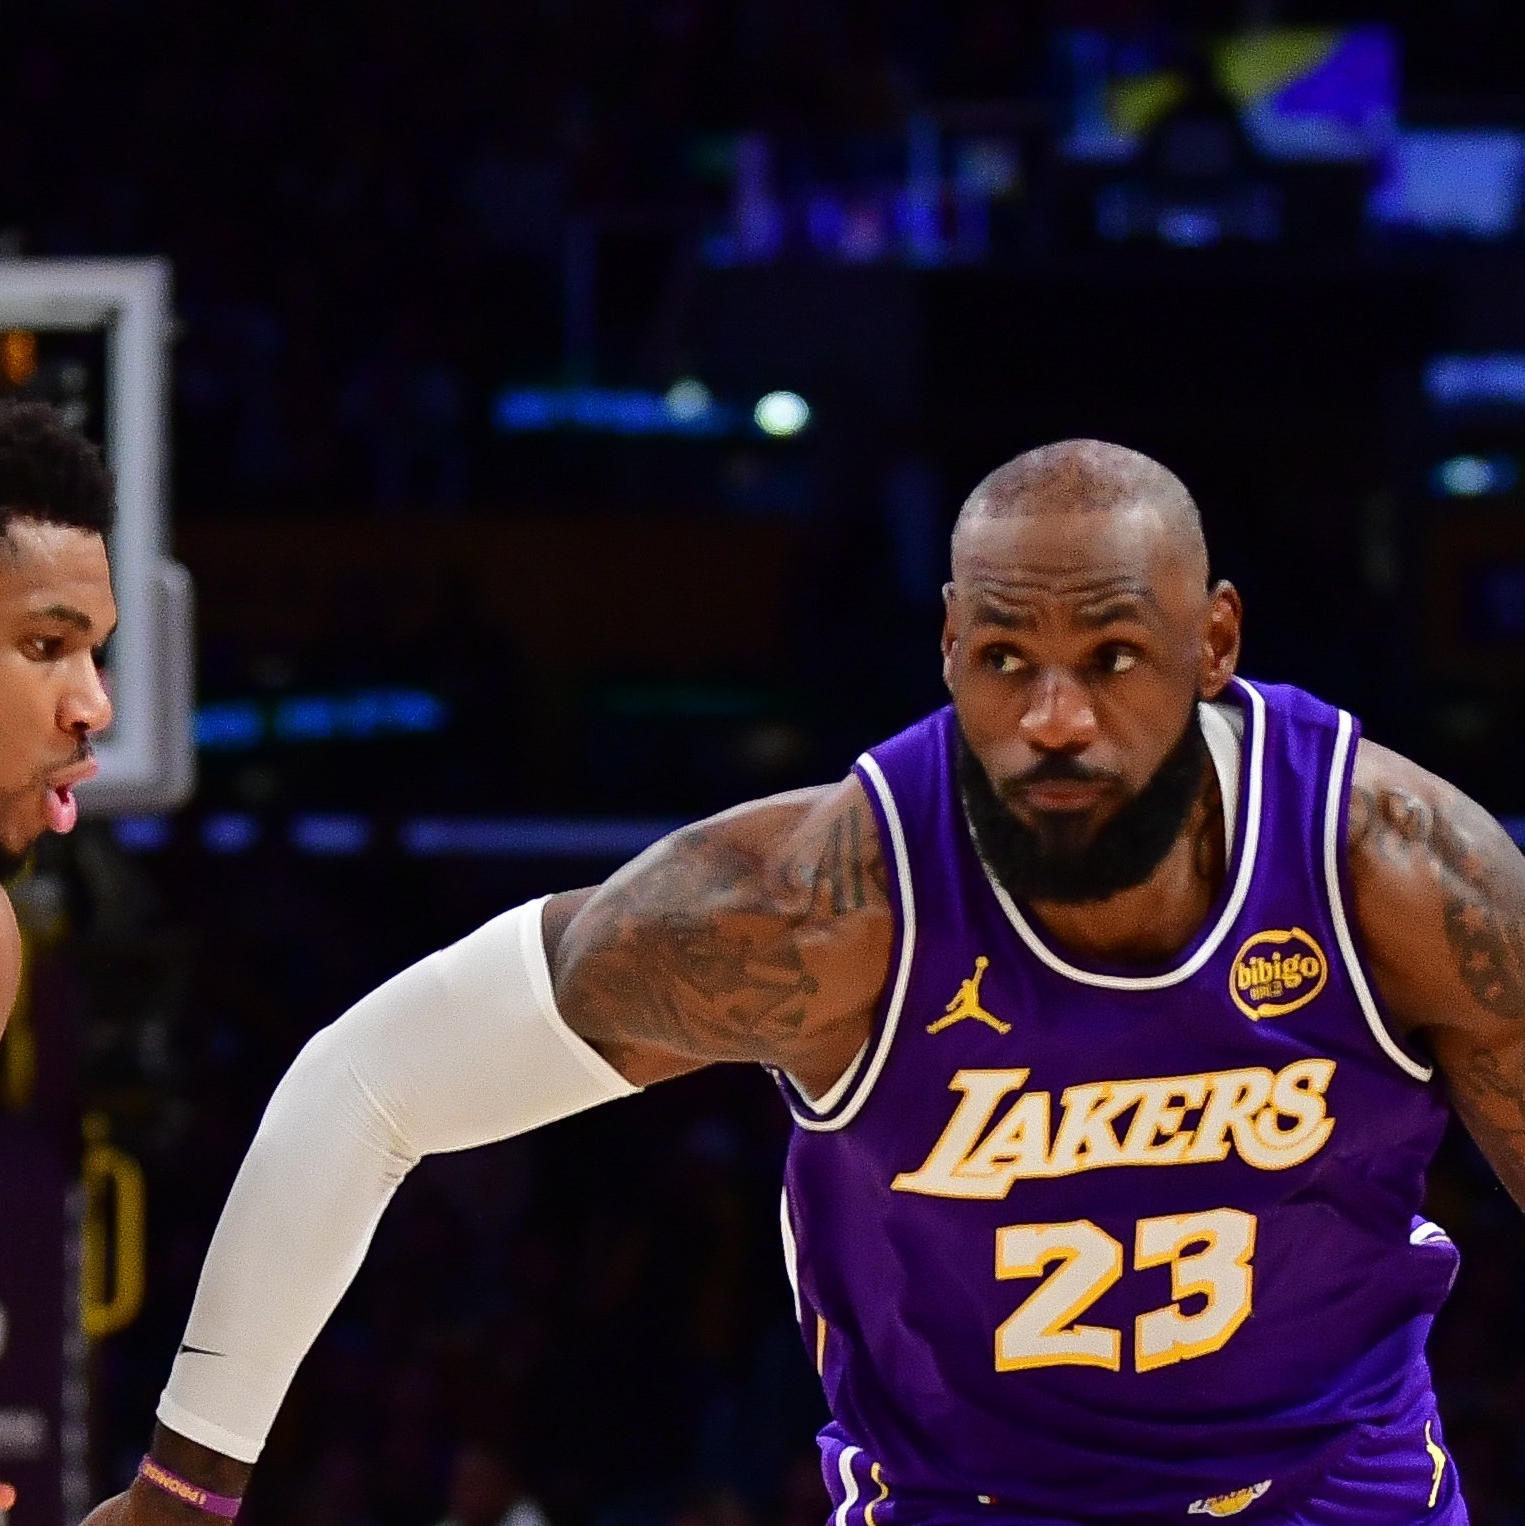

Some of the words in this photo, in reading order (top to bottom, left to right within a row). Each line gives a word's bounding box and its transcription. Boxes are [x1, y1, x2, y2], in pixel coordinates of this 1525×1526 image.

[1237, 951, 1320, 991] bibigo
[891, 1057, 1337, 1200] LAKERS
[994, 1206, 1259, 1373] 23
